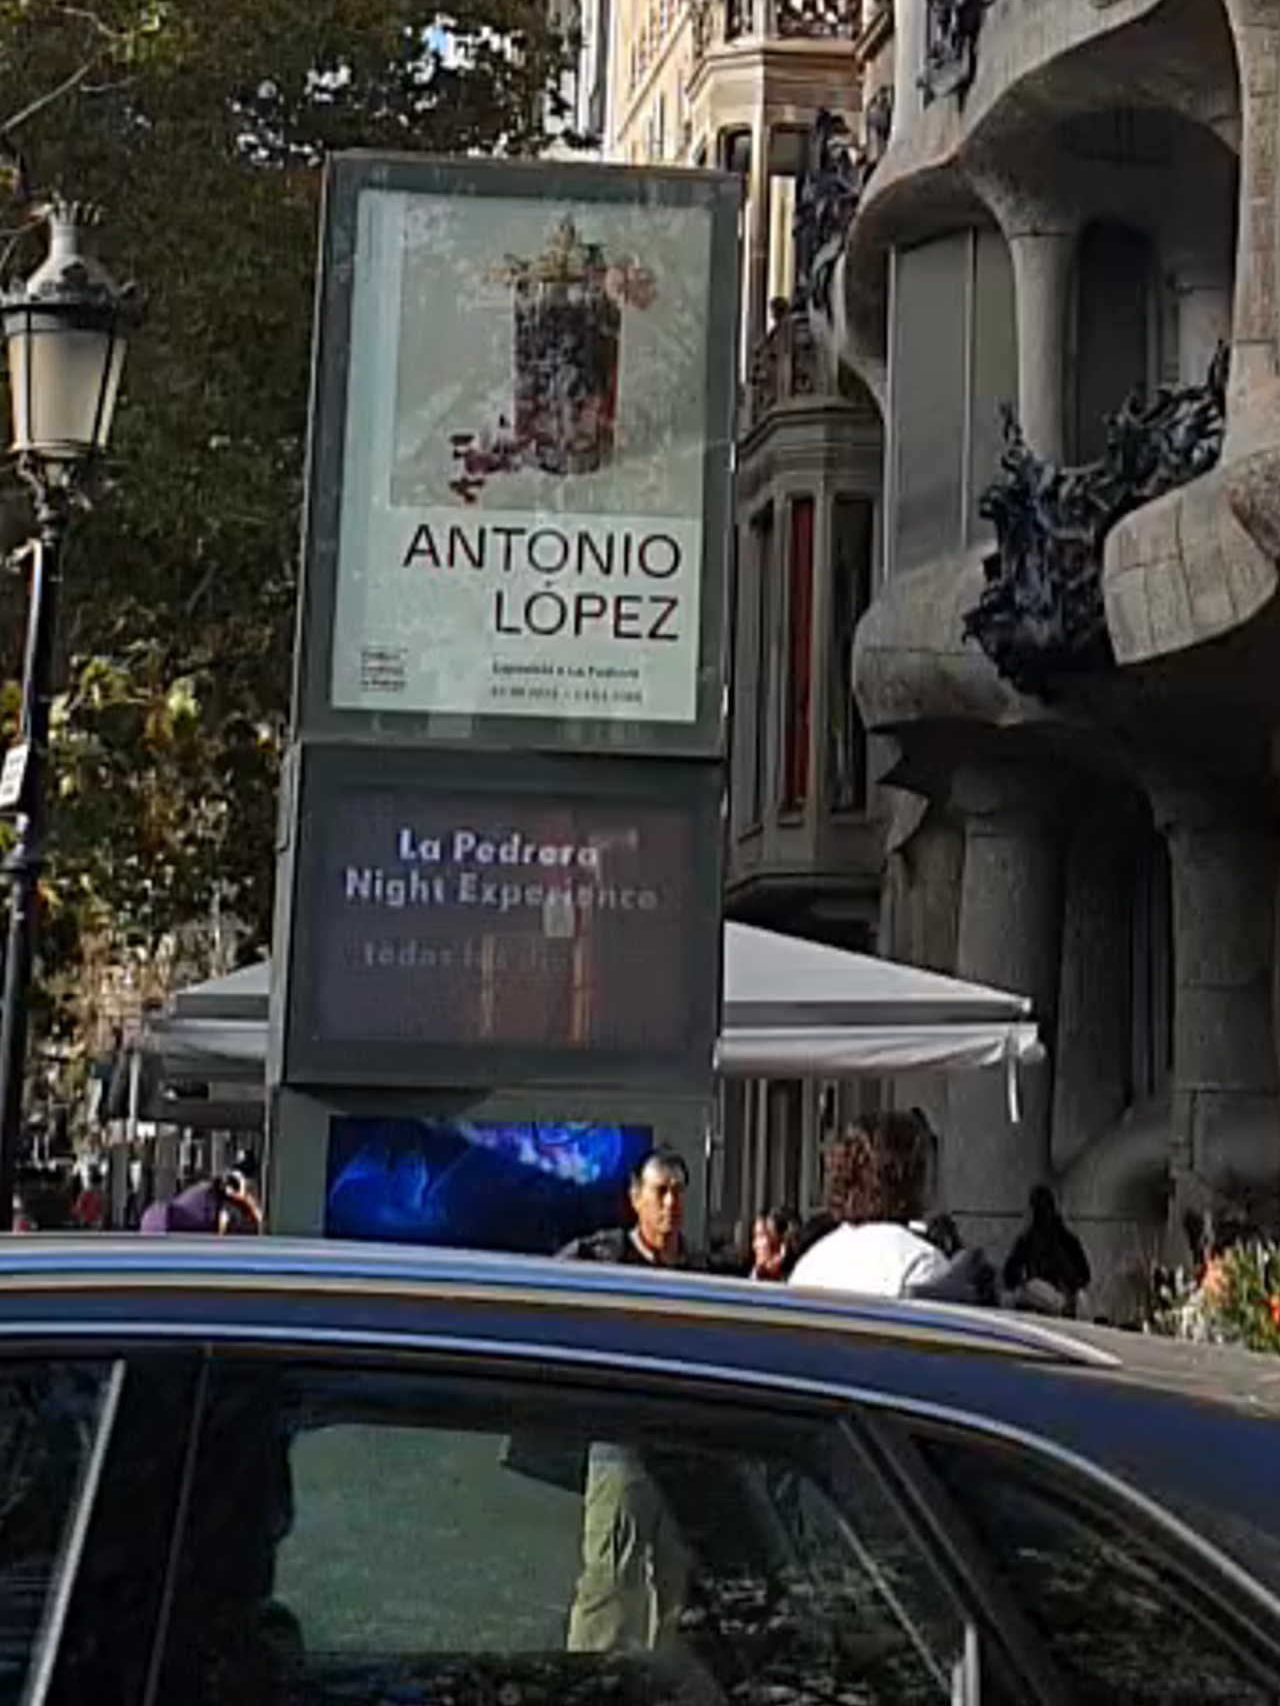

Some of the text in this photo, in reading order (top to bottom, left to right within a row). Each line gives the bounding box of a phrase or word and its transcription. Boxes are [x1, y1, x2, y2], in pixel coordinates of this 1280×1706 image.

[402, 523, 682, 579] ANTONIO
[494, 580, 680, 642] LÓPEZ
[399, 829, 599, 866] La Pedrera
[346, 867, 659, 912] Night Experience
